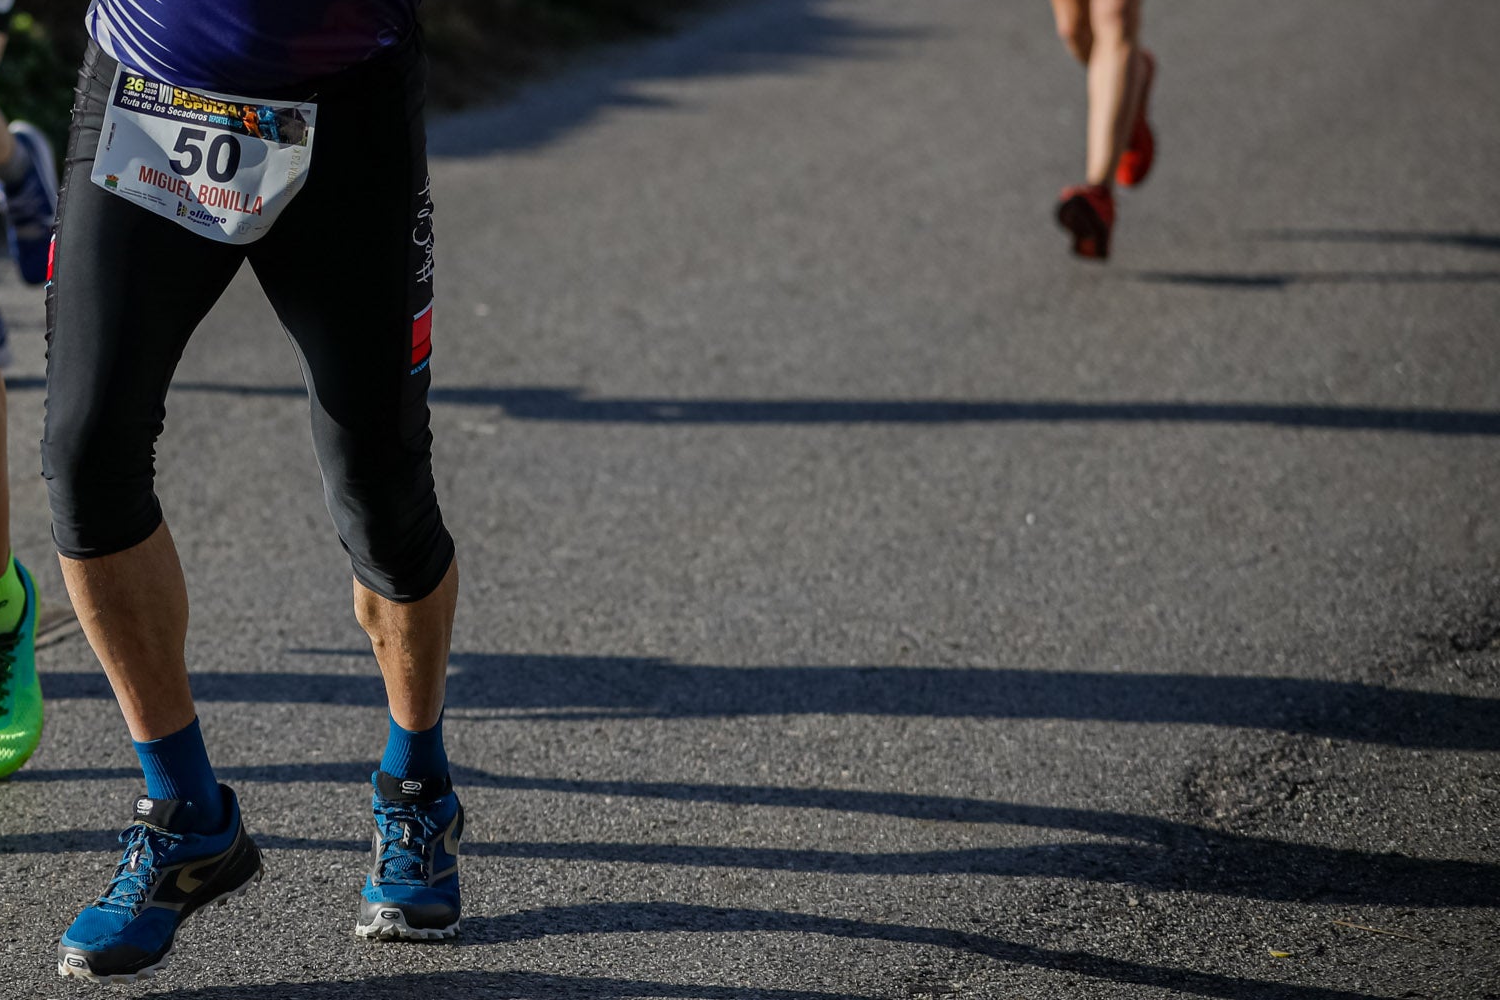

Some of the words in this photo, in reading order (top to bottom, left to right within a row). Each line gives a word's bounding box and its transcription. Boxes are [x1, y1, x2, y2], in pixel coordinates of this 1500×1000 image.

[124, 76, 145, 92] 26
[158, 82, 174, 105] VII
[120, 96, 140, 108] Ruta
[141, 100, 152, 110] de
[153, 103, 166, 114] los
[167, 106, 208, 122] Secaderos
[168, 126, 242, 184] 50
[138, 165, 193, 203] MIGUEL
[198, 184, 264, 217] BONILLA
[189, 209, 228, 226] olimpo
